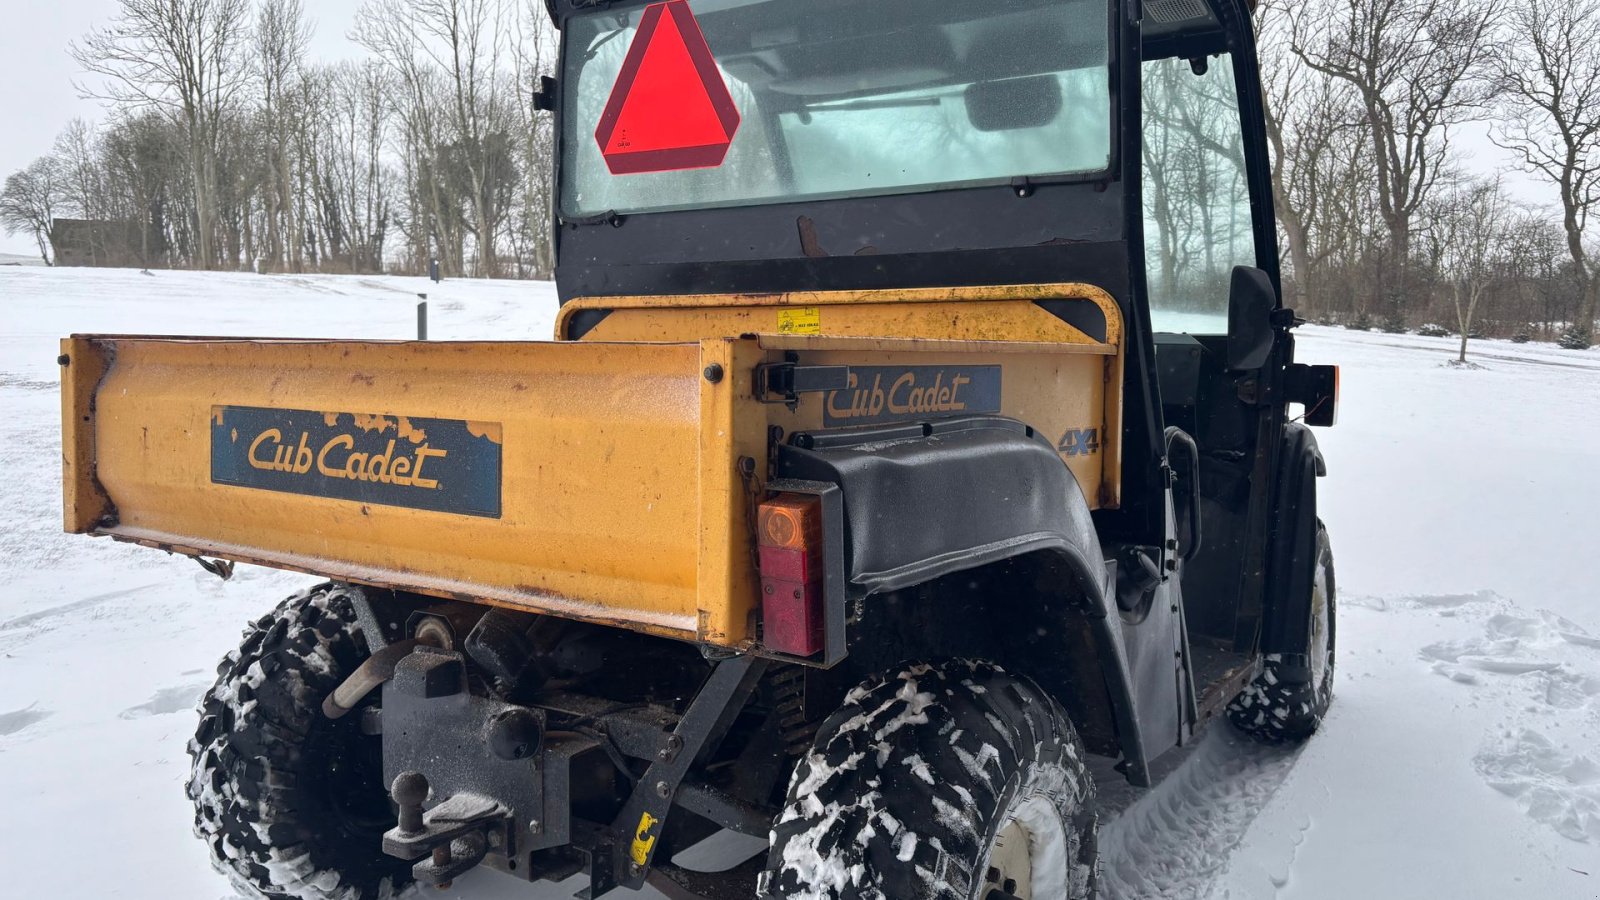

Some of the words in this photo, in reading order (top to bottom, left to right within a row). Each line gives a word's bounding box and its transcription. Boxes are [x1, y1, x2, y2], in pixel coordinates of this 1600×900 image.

[827, 372, 884, 418] Cub
[887, 371, 970, 414] Cadet
[248, 428, 313, 474] Cub
[317, 433, 447, 489] Cadet
